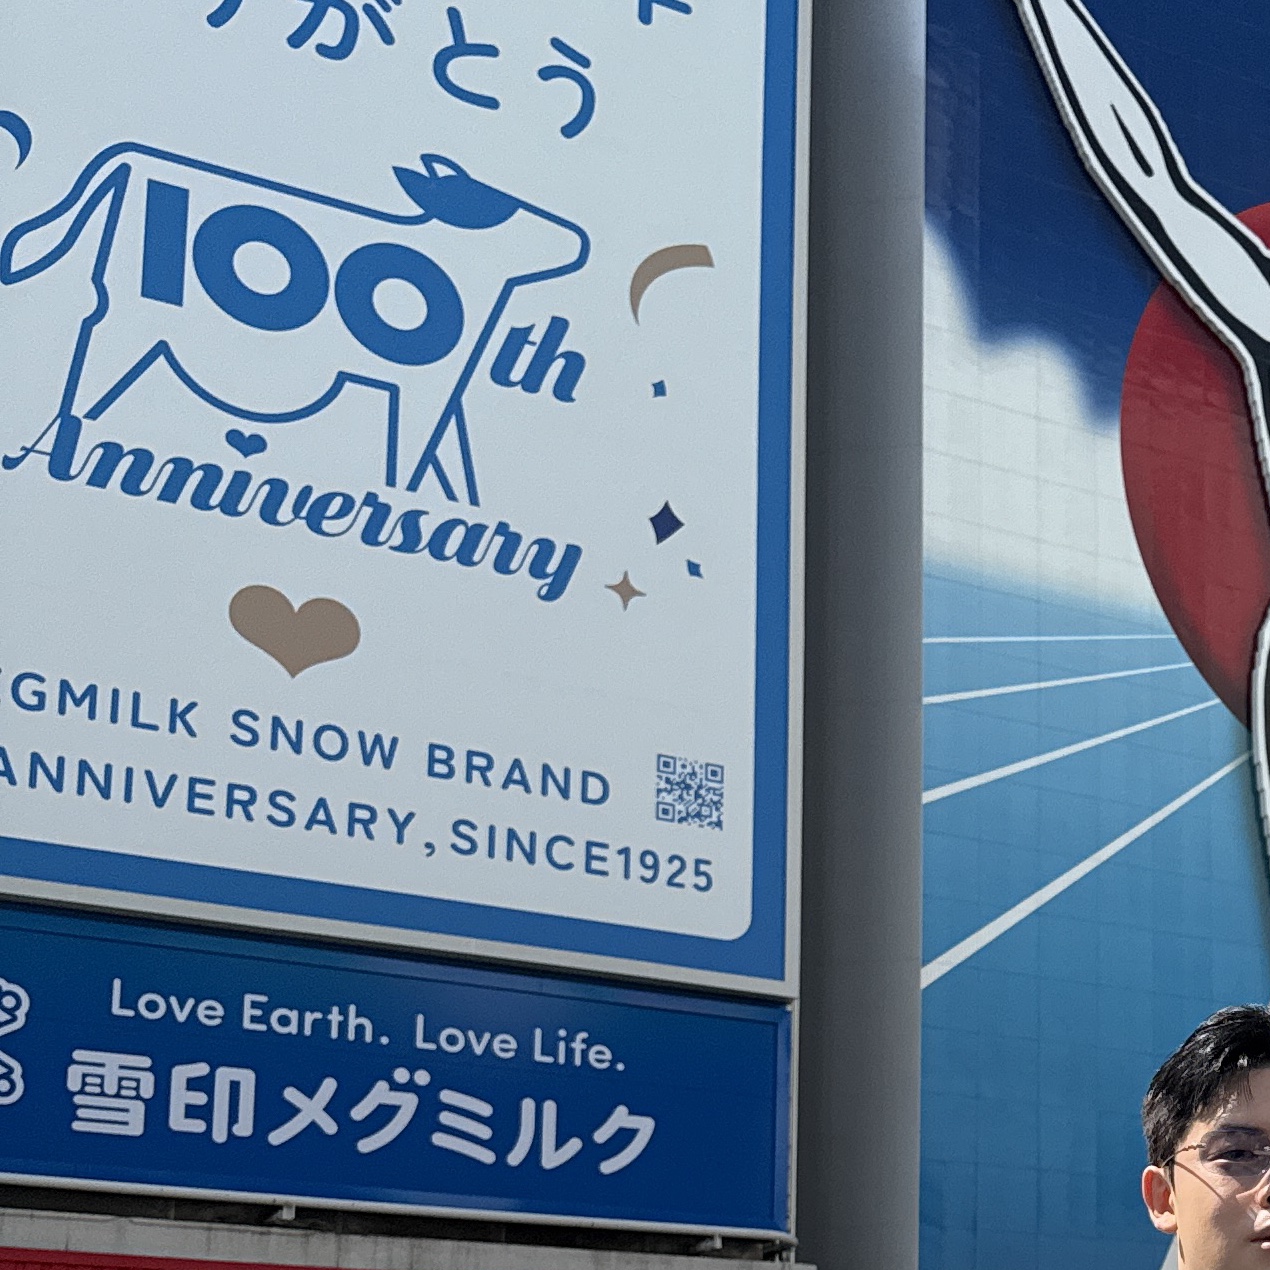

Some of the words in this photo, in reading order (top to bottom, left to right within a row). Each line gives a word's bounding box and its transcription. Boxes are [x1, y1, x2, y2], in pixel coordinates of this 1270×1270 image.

[2, 411, 583, 602] Anniversary
[0, 670, 199, 738] GMILK
[229, 709, 400, 770] SNOW
[426, 743, 611, 805] BRAND
[110, 977, 225, 1028] Love
[242, 993, 390, 1046] Earth.
[415, 1013, 519, 1060] Love
[533, 1027, 626, 1072] Life.
[66, 1048, 656, 1175] 雪印メグミルク
